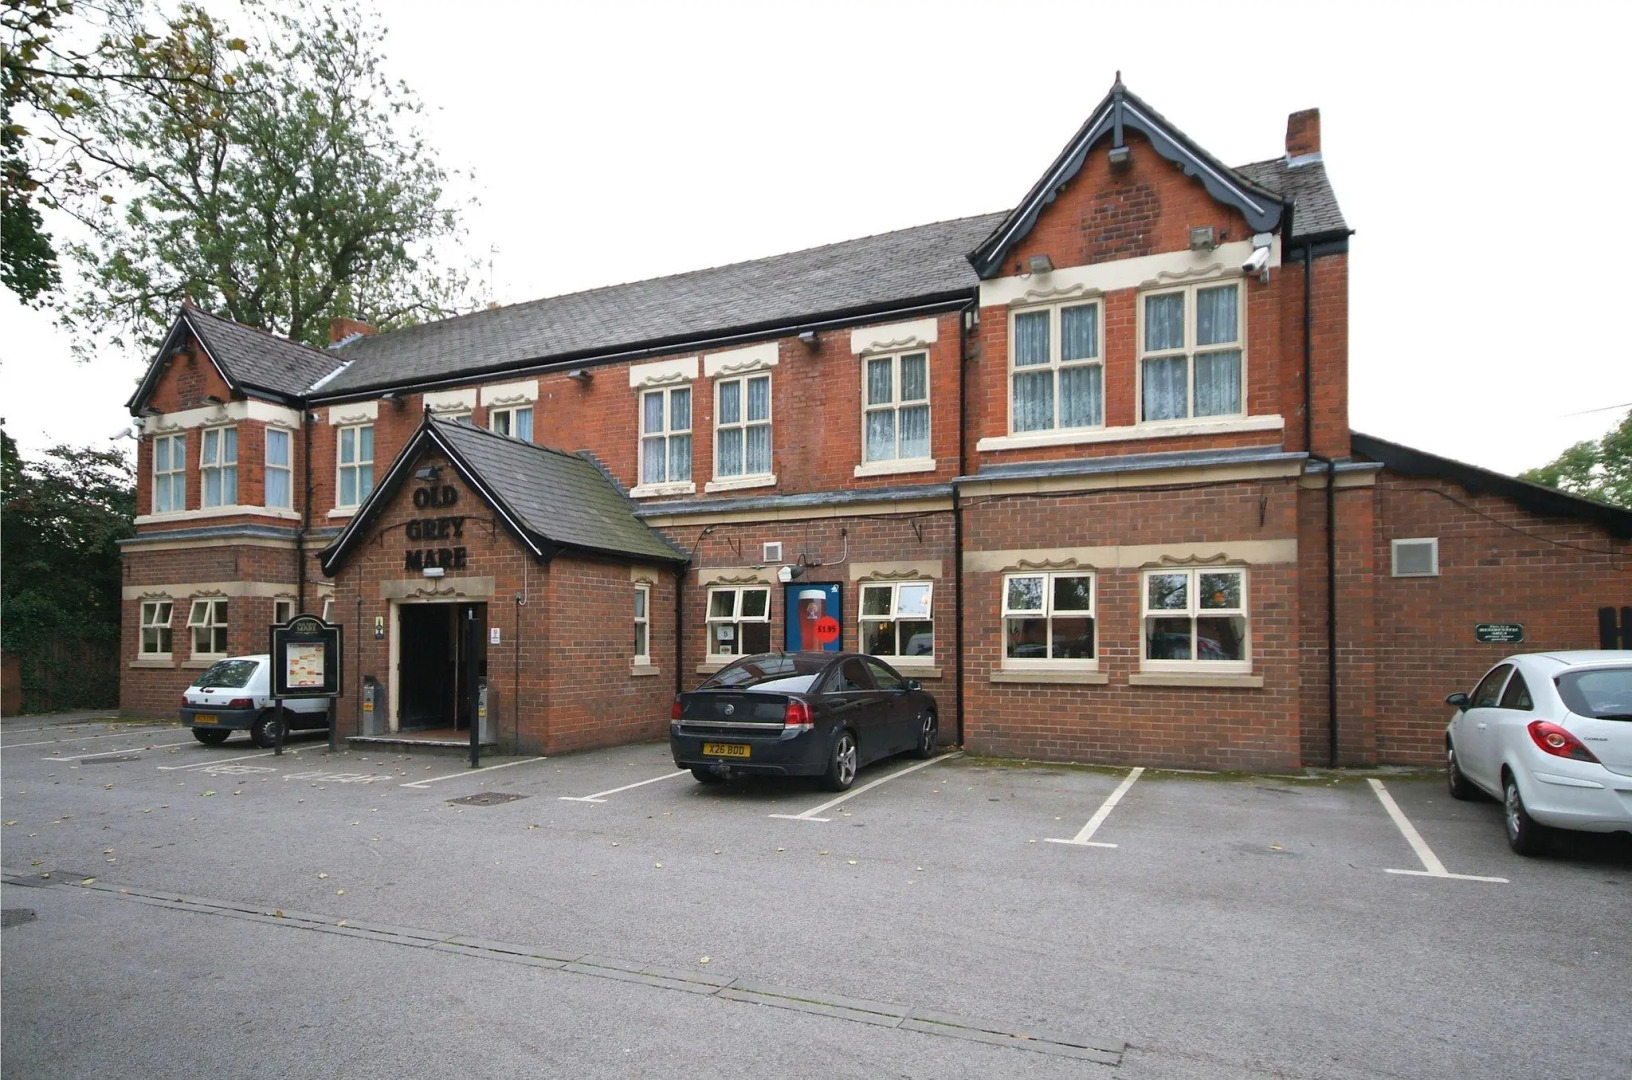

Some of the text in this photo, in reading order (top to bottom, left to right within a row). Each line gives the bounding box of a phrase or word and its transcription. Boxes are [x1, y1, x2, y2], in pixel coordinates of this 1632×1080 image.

[413, 485, 458, 509] OLD
[405, 516, 463, 541] GREY
[405, 546, 467, 571] MARE
[817, 625, 837, 633] £1.95
[709, 745, 745, 755] X26 BDD
